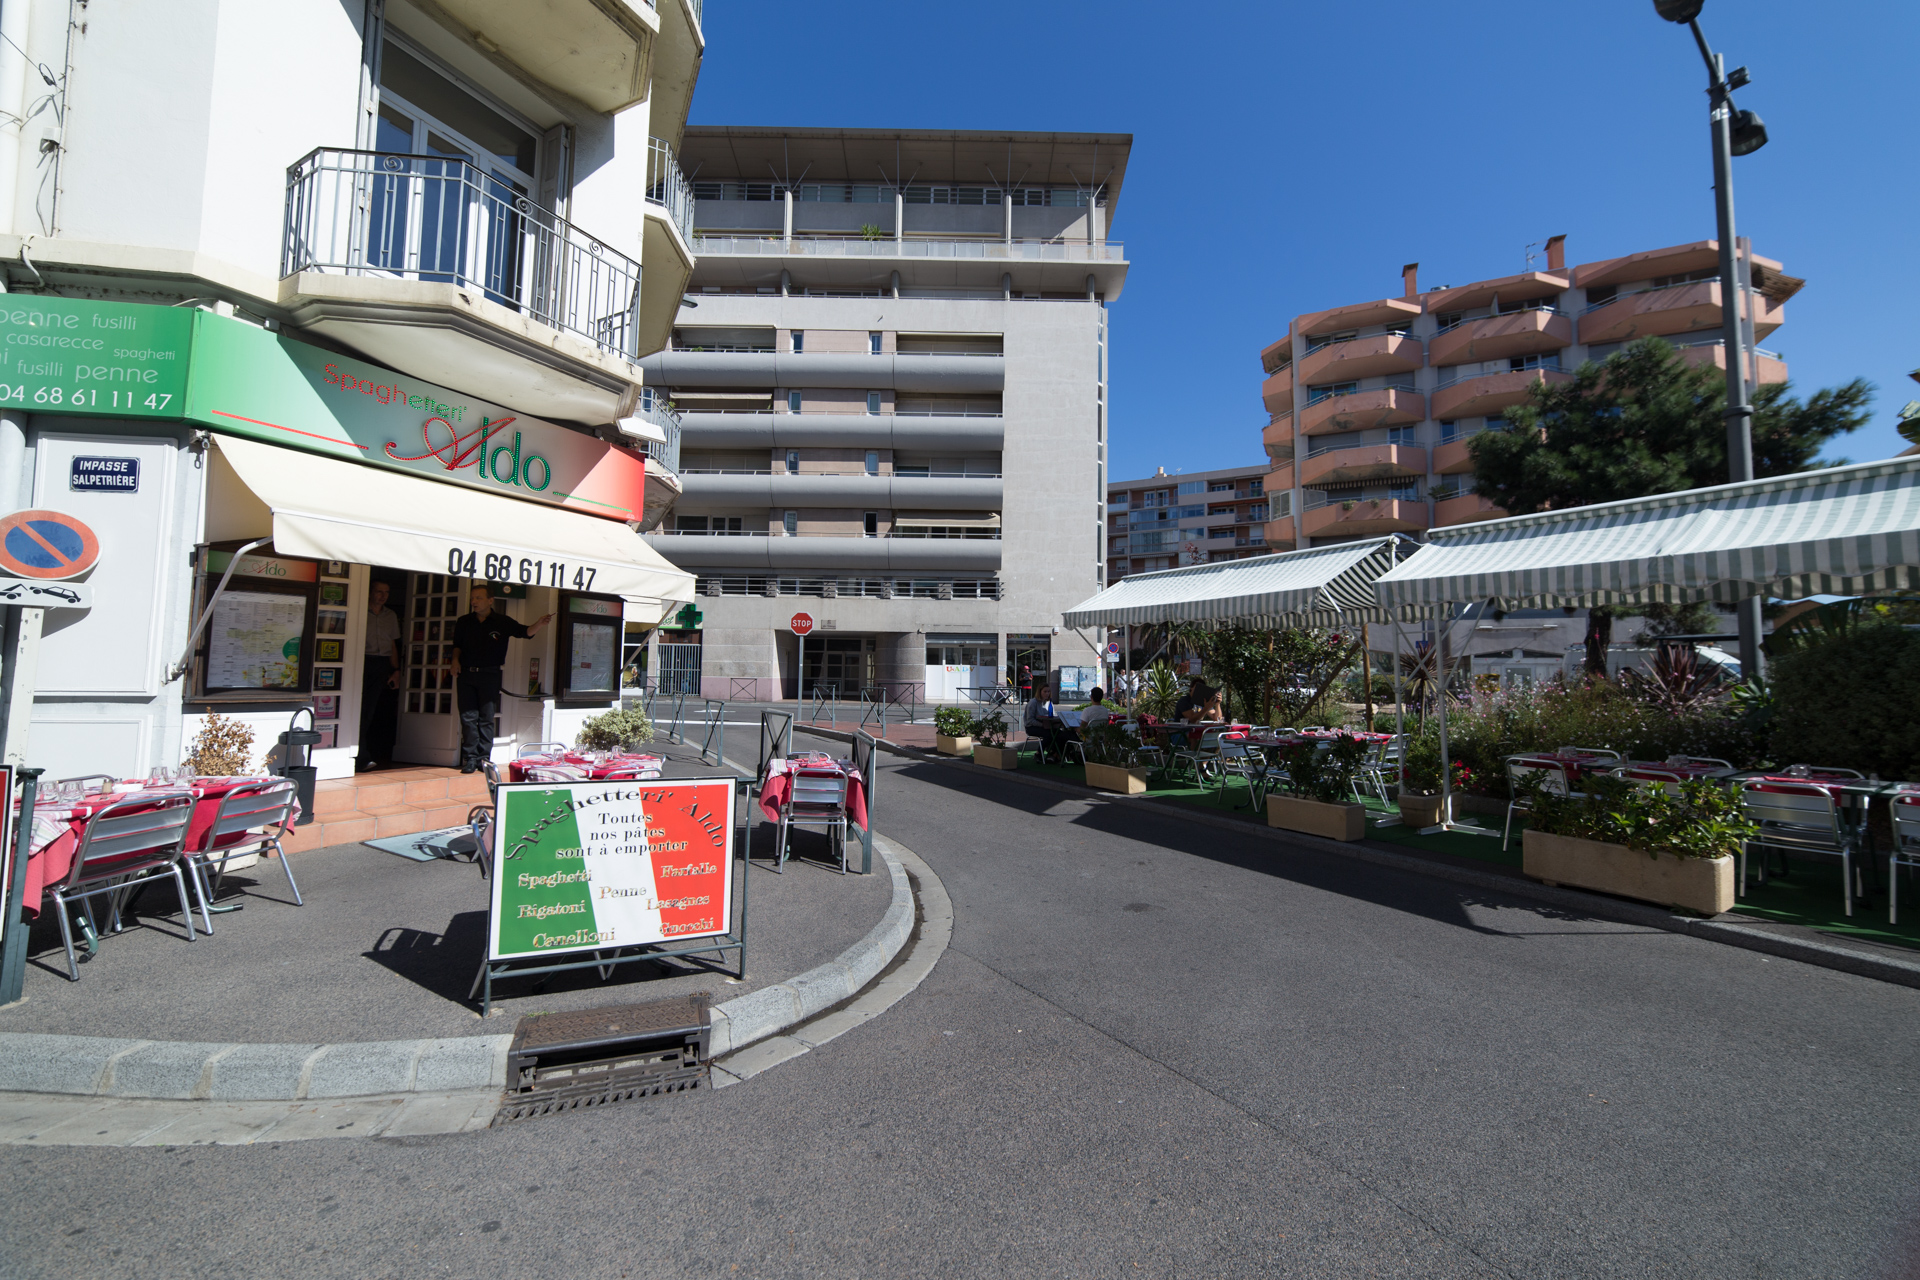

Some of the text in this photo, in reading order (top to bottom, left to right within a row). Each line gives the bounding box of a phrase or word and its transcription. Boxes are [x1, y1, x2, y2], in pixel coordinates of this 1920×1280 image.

[92, 313, 137, 330] fusilli
[6, 333, 104, 350] casarecce
[113, 348, 176, 361] spaghetti
[17, 359, 159, 384] fusilli penne
[0, 383, 173, 410] 04 68 61 11 47
[384, 416, 551, 492] Aldo
[79, 460, 129, 472] IMPASSE
[72, 474, 136, 487] SALPETRIÈRE
[242, 560, 287, 577] Aldo
[447, 547, 597, 592] 04 68 61 11 47
[792, 619, 812, 627] STOP
[598, 811, 653, 825] Toutes
[678, 802, 724, 848] Aldo
[590, 826, 666, 842] nos pâtes
[556, 840, 688, 859] sont à emporter
[660, 862, 718, 879] Farfalle
[517, 869, 593, 890] Spaghetti
[598, 885, 647, 900] Penne
[517, 900, 587, 920] Rigatoni
[645, 894, 710, 911] Lasagnes
[659, 917, 715, 935] Gnocchi
[532, 927, 617, 949] Canelloni
